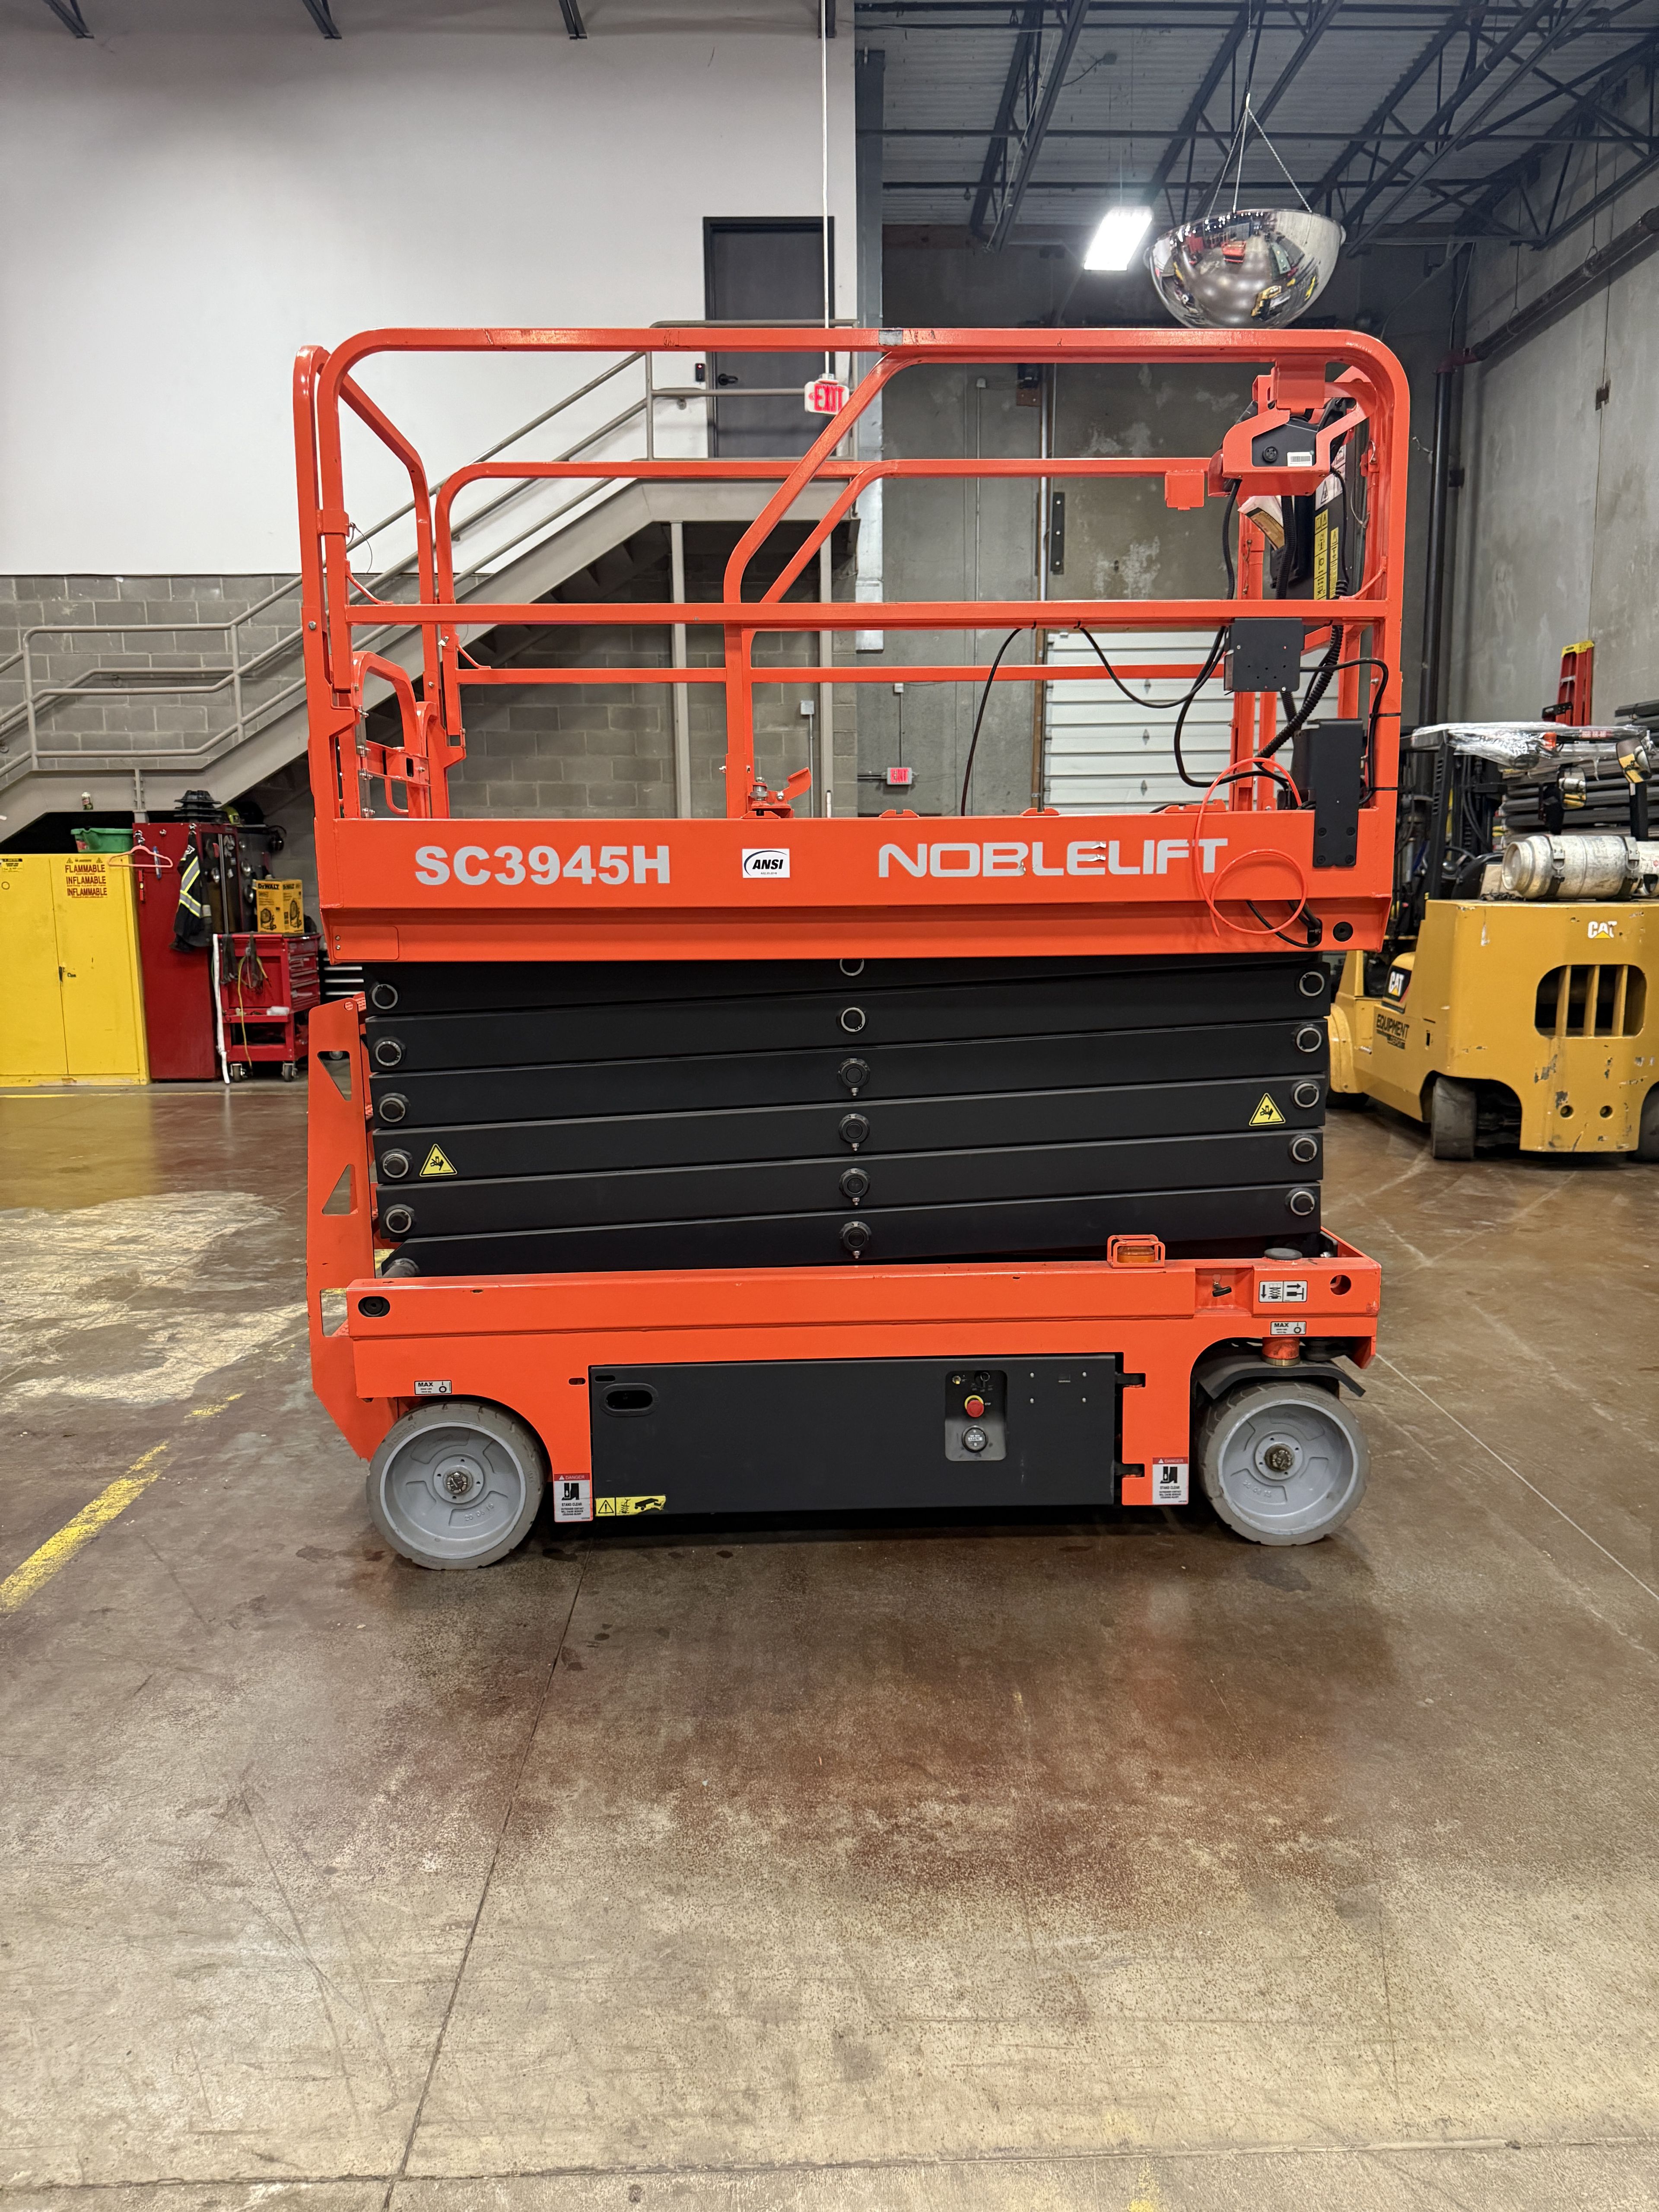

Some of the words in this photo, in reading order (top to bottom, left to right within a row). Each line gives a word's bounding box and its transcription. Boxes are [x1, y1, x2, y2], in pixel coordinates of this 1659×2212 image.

[814, 384, 845, 412] EXIT
[415, 845, 670, 885] SC3945H
[752, 859, 783, 869] ANSI
[879, 838, 1228, 877] NOBLELIFT
[65, 864, 105, 873] FLAMMABLE
[66, 876, 106, 884] INFLAMABLE
[67, 888, 108, 896] INFLAMMABLE
[1588, 921, 1617, 939] CAT
[1389, 971, 1405, 997] CAT
[1376, 1014, 1410, 1039] EQUIPMENT
